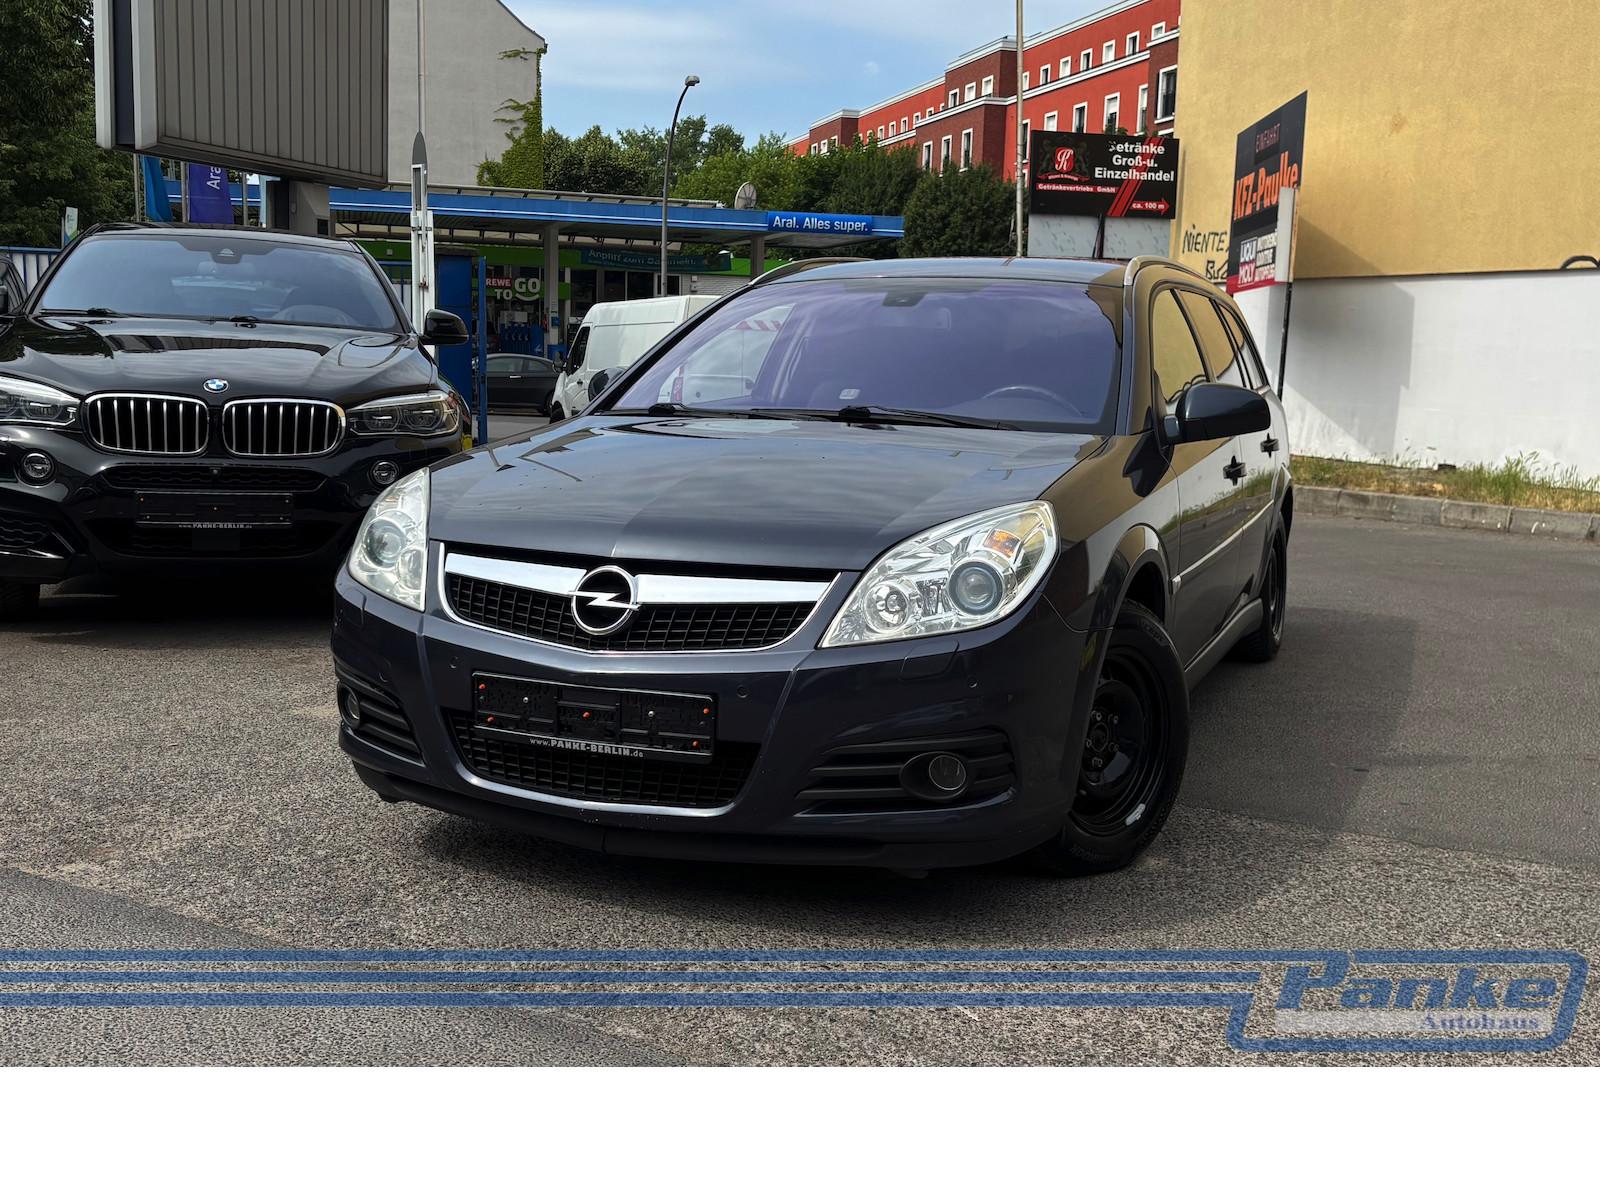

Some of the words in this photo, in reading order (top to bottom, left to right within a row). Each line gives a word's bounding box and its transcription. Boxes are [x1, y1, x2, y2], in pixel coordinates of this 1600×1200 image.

[206, 166, 221, 190] Ara
[1094, 167, 1175, 182] Einzelhandel
[1038, 183, 1094, 193] Getränkevertriebs
[773, 215, 799, 229] Aral.
[803, 217, 831, 230] Alles
[834, 220, 868, 232] super.
[485, 278, 511, 287] REWE
[514, 277, 541, 293] GO
[494, 288, 513, 300] TO
[529, 737, 644, 758] www.PANKE-BERLIN.de
